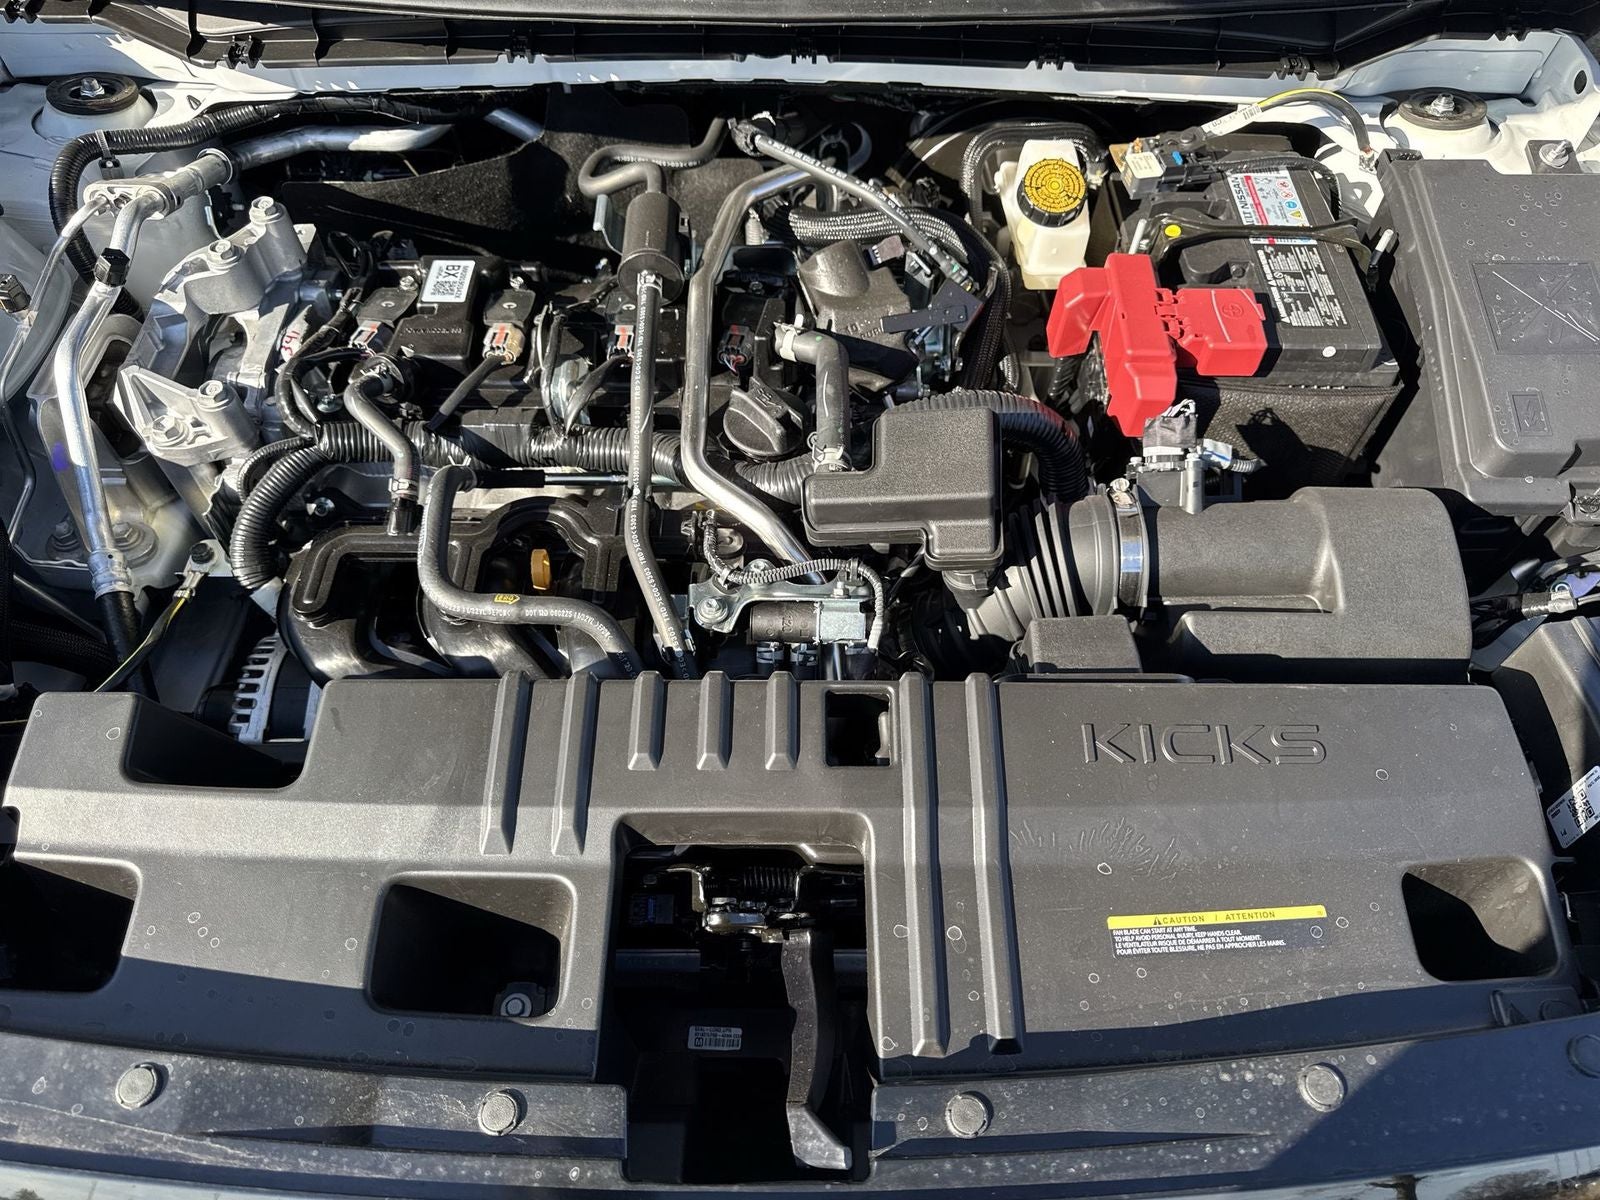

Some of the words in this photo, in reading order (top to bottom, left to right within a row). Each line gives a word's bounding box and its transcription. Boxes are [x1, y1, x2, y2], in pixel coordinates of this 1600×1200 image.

[1231, 176, 1249, 210] NISSAN
[445, 264, 462, 279] BX
[1081, 723, 1327, 765] KICKS
[1162, 915, 1205, 925] CAUTION
[1225, 911, 1276, 921] ATTENTION
[1224, 941, 1257, 949] APPROCHER
